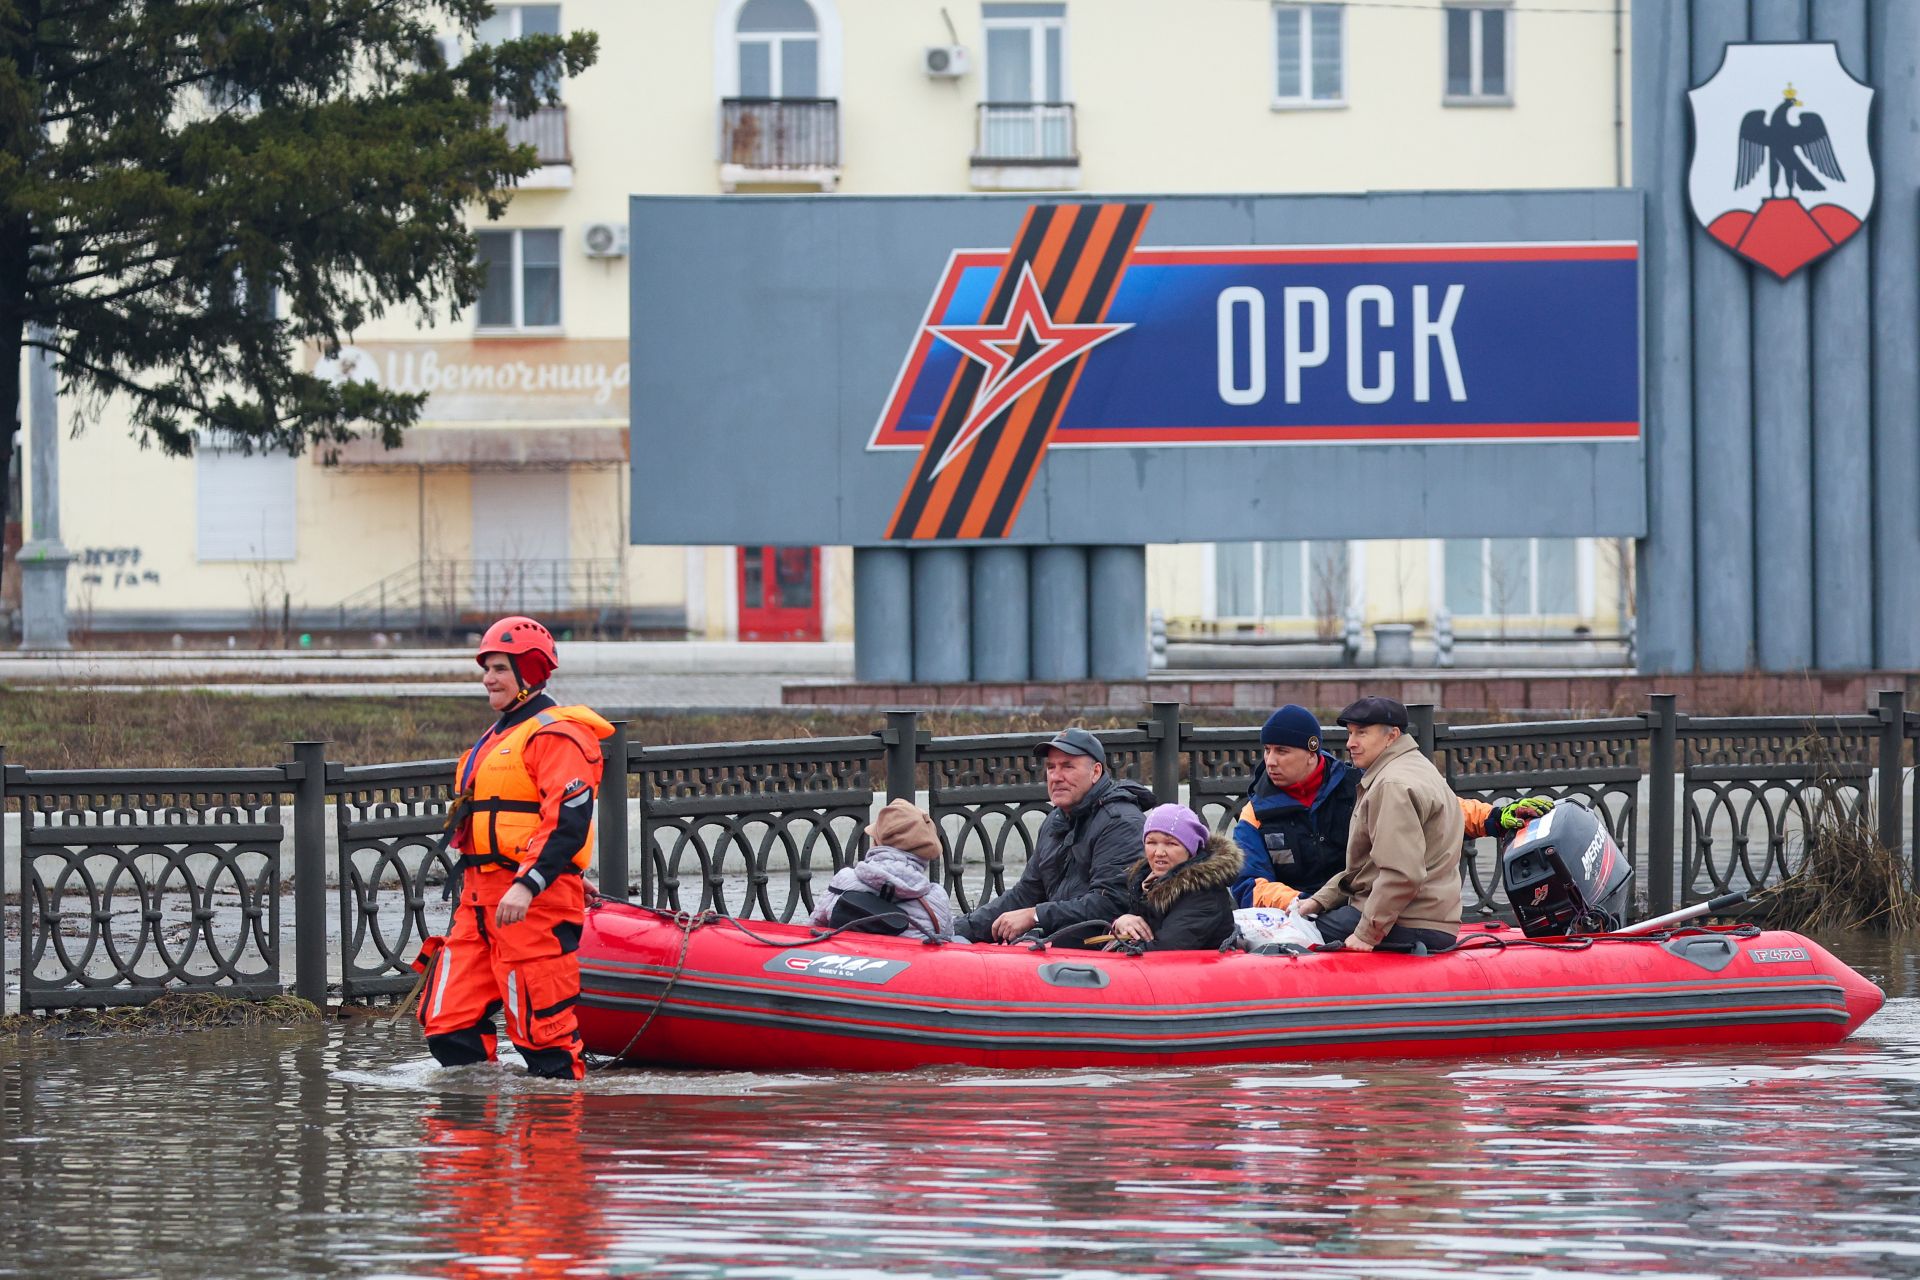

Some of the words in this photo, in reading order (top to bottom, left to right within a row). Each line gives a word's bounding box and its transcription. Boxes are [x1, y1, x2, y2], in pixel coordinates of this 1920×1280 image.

[1216, 284, 1468, 406] ОРСК
[1754, 950, 1768, 961] F
[1769, 948, 1805, 961] 470
